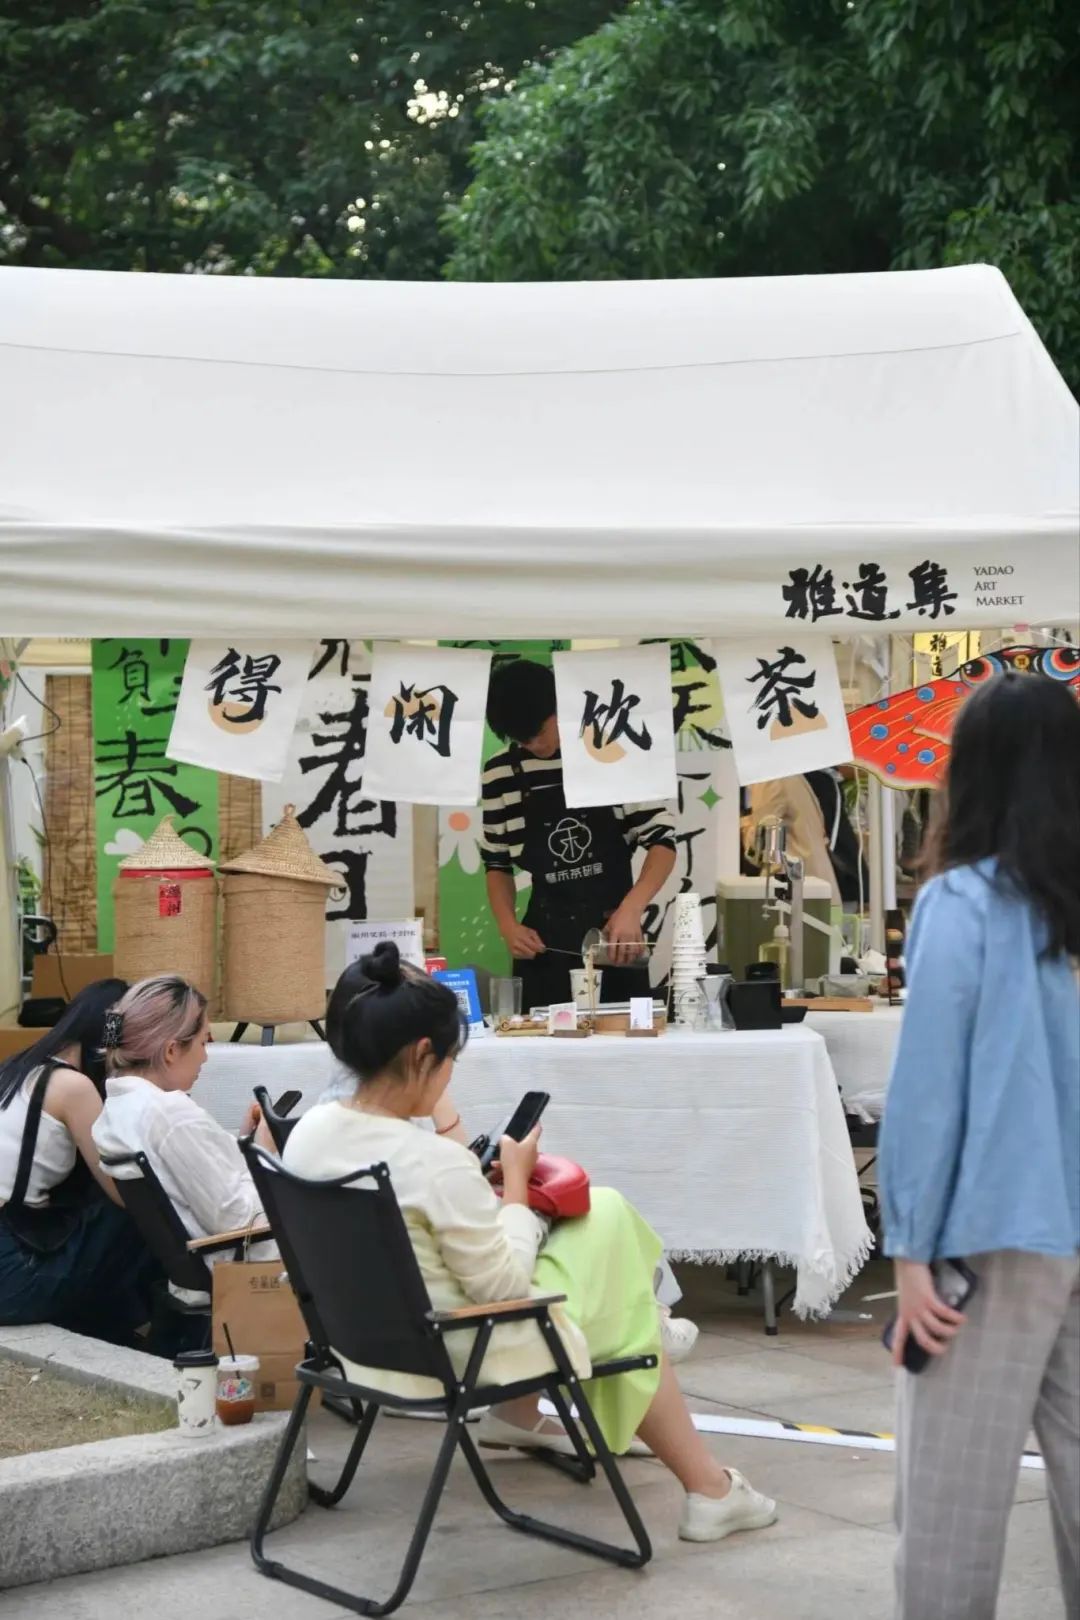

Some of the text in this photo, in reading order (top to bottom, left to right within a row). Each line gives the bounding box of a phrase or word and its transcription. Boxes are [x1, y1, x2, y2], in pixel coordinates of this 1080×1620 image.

[973, 565, 1015, 577] YADAO
[782, 560, 958, 623] 雅道集
[974, 580, 998, 592] ART
[976, 595, 1025, 607] MARKET
[203, 646, 818, 758] 得 闲 饮 茶
